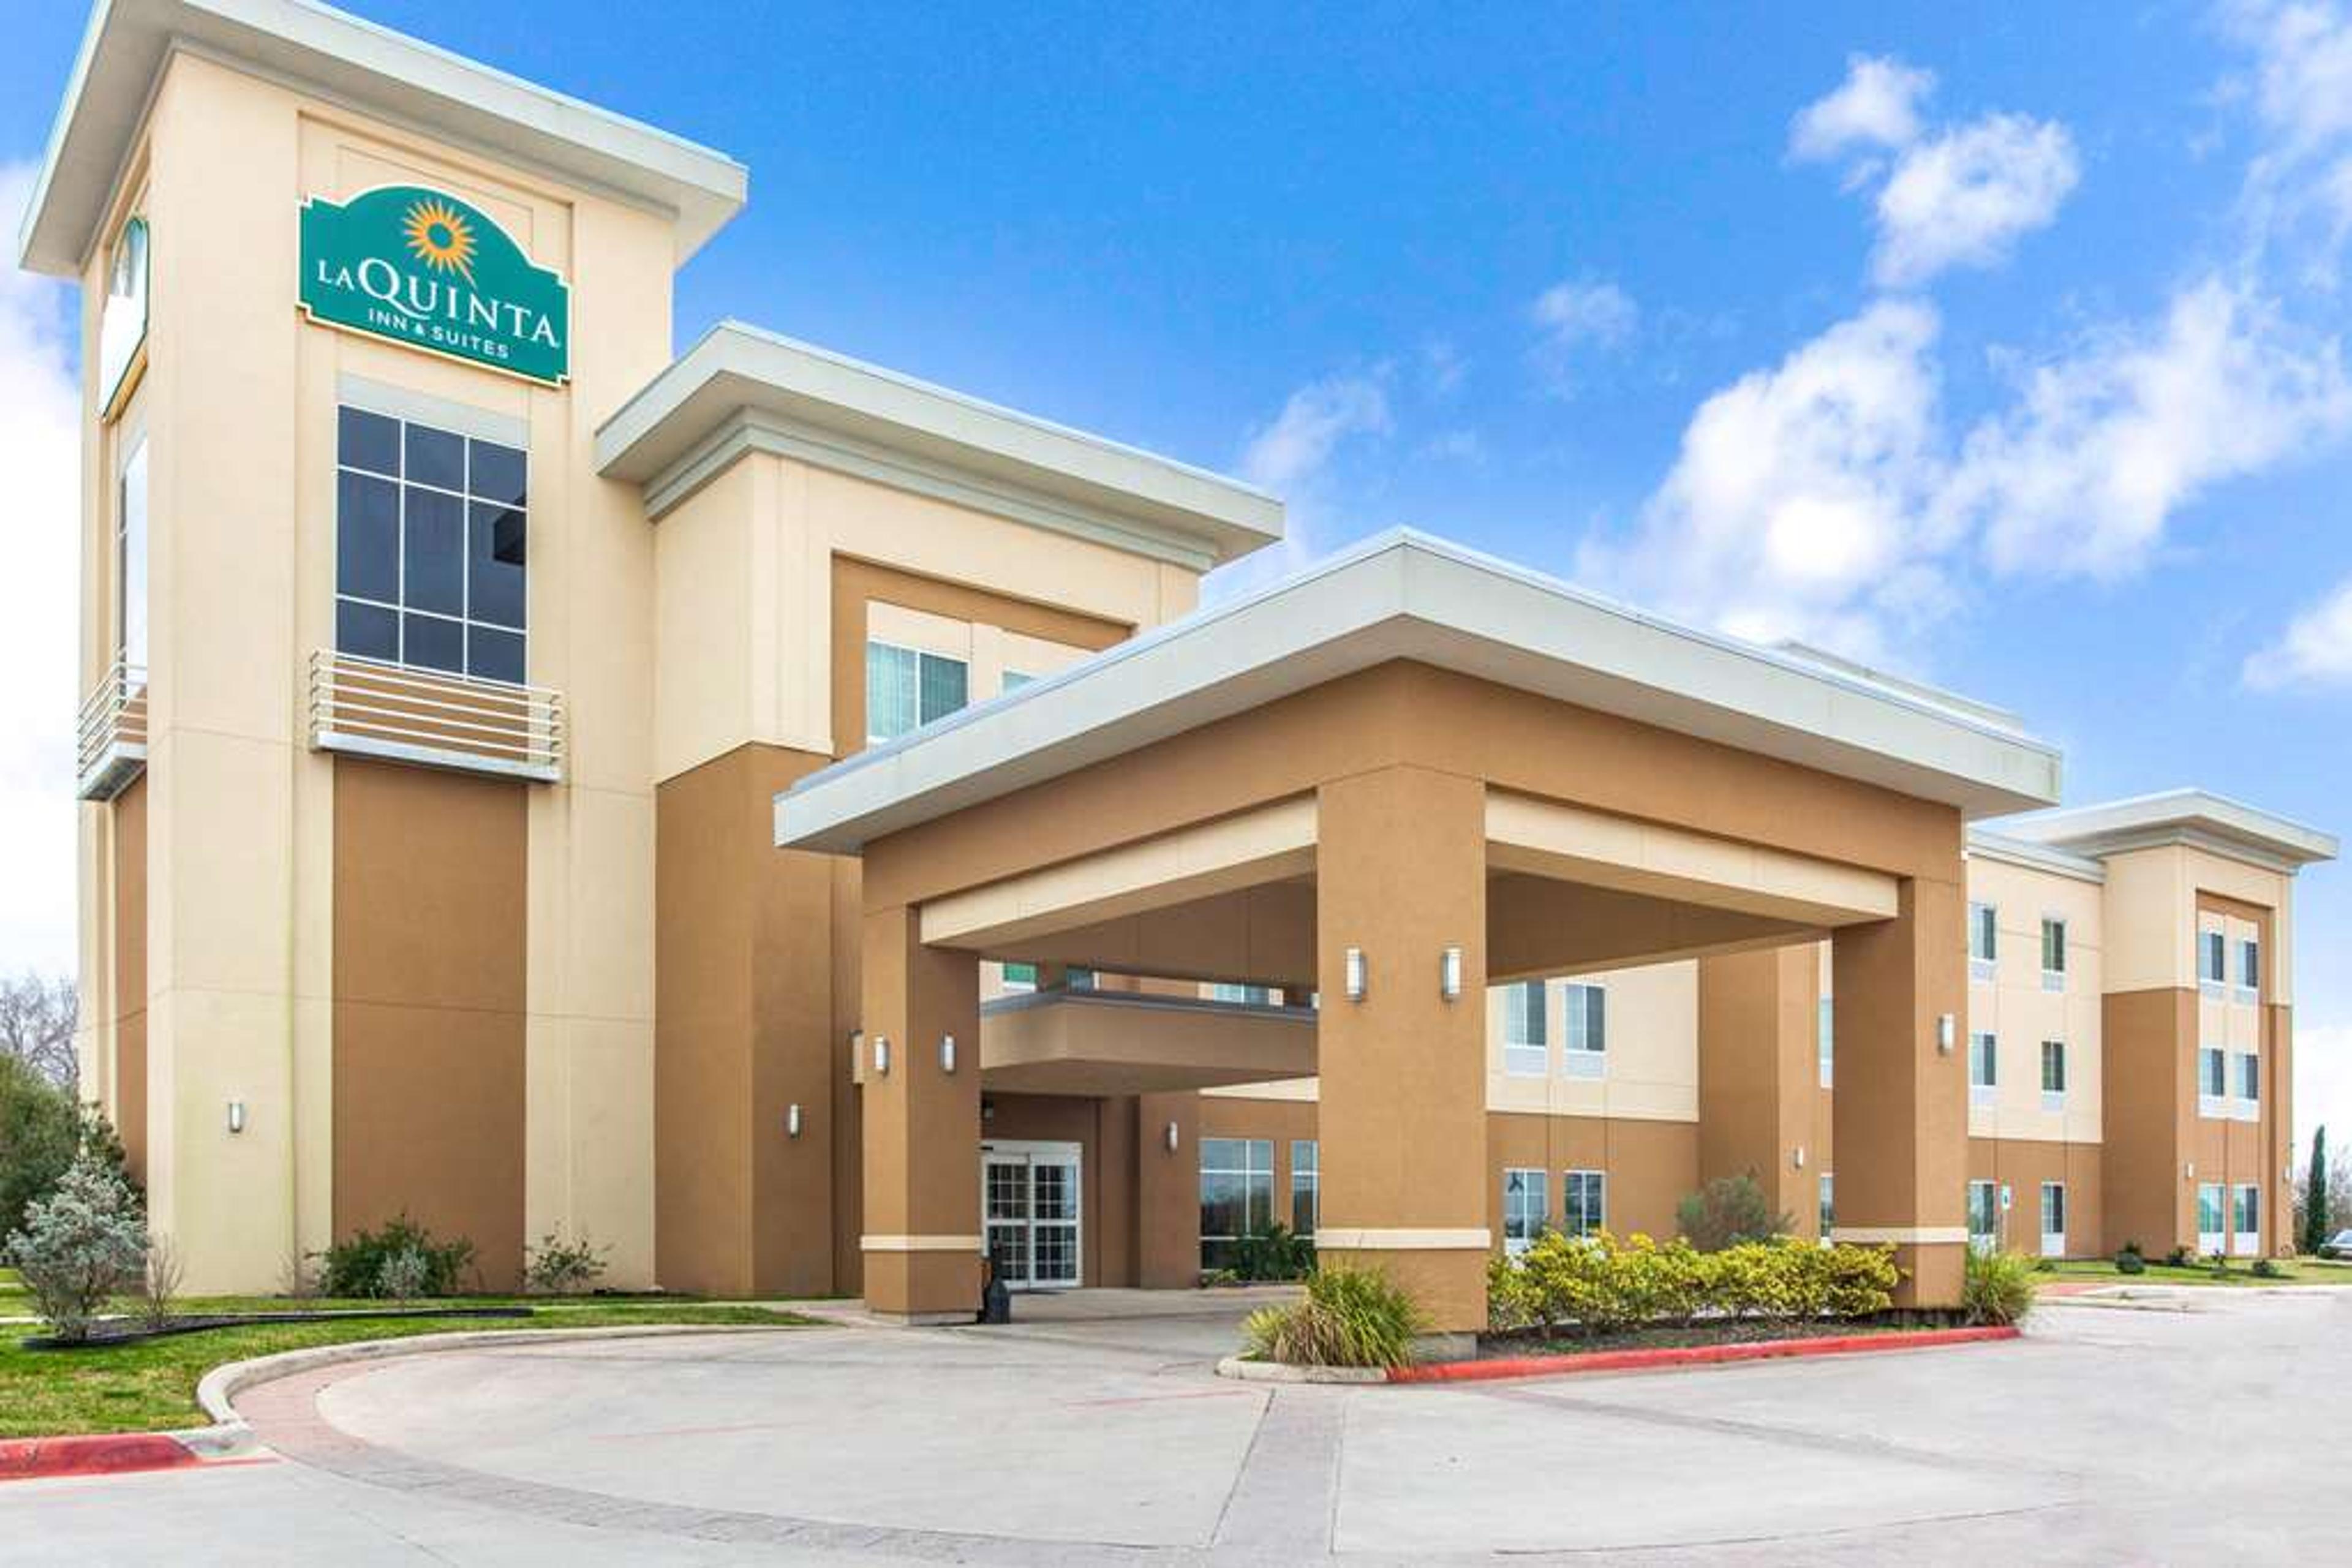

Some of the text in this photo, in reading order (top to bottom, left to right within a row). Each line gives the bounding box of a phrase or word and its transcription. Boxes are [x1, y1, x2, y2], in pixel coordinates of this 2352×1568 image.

[318, 257, 560, 348] LA QUINTA
[368, 307, 407, 331] INN
[431, 326, 509, 359] SUITES
